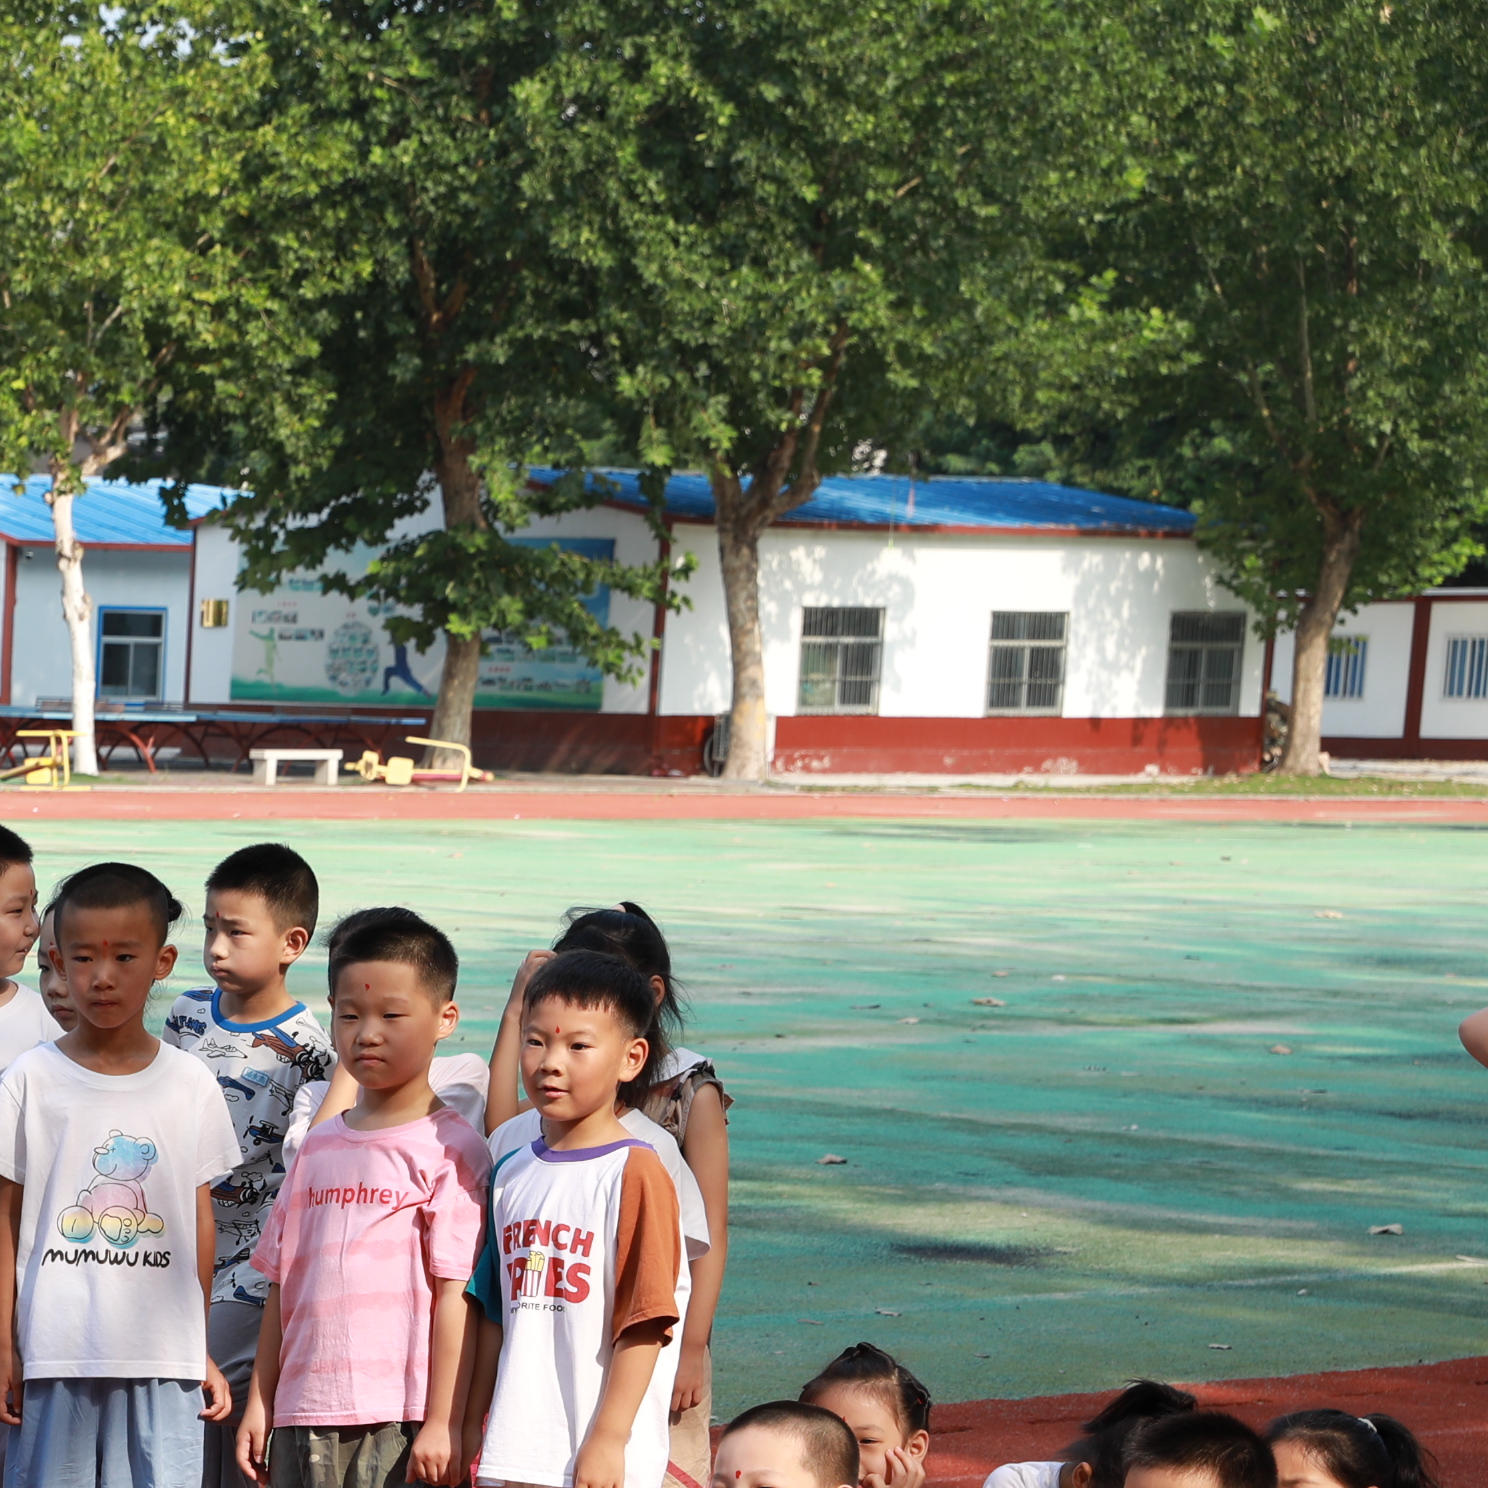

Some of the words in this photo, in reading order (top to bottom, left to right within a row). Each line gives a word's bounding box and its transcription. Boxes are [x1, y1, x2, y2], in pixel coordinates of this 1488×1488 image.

[308, 1181, 410, 1211] humphrey
[502, 1218, 595, 1258] FRENCH
[41, 1248, 140, 1267] MUMUWU
[142, 1250, 172, 1269] KIDS
[543, 1304, 565, 1313] FOO
